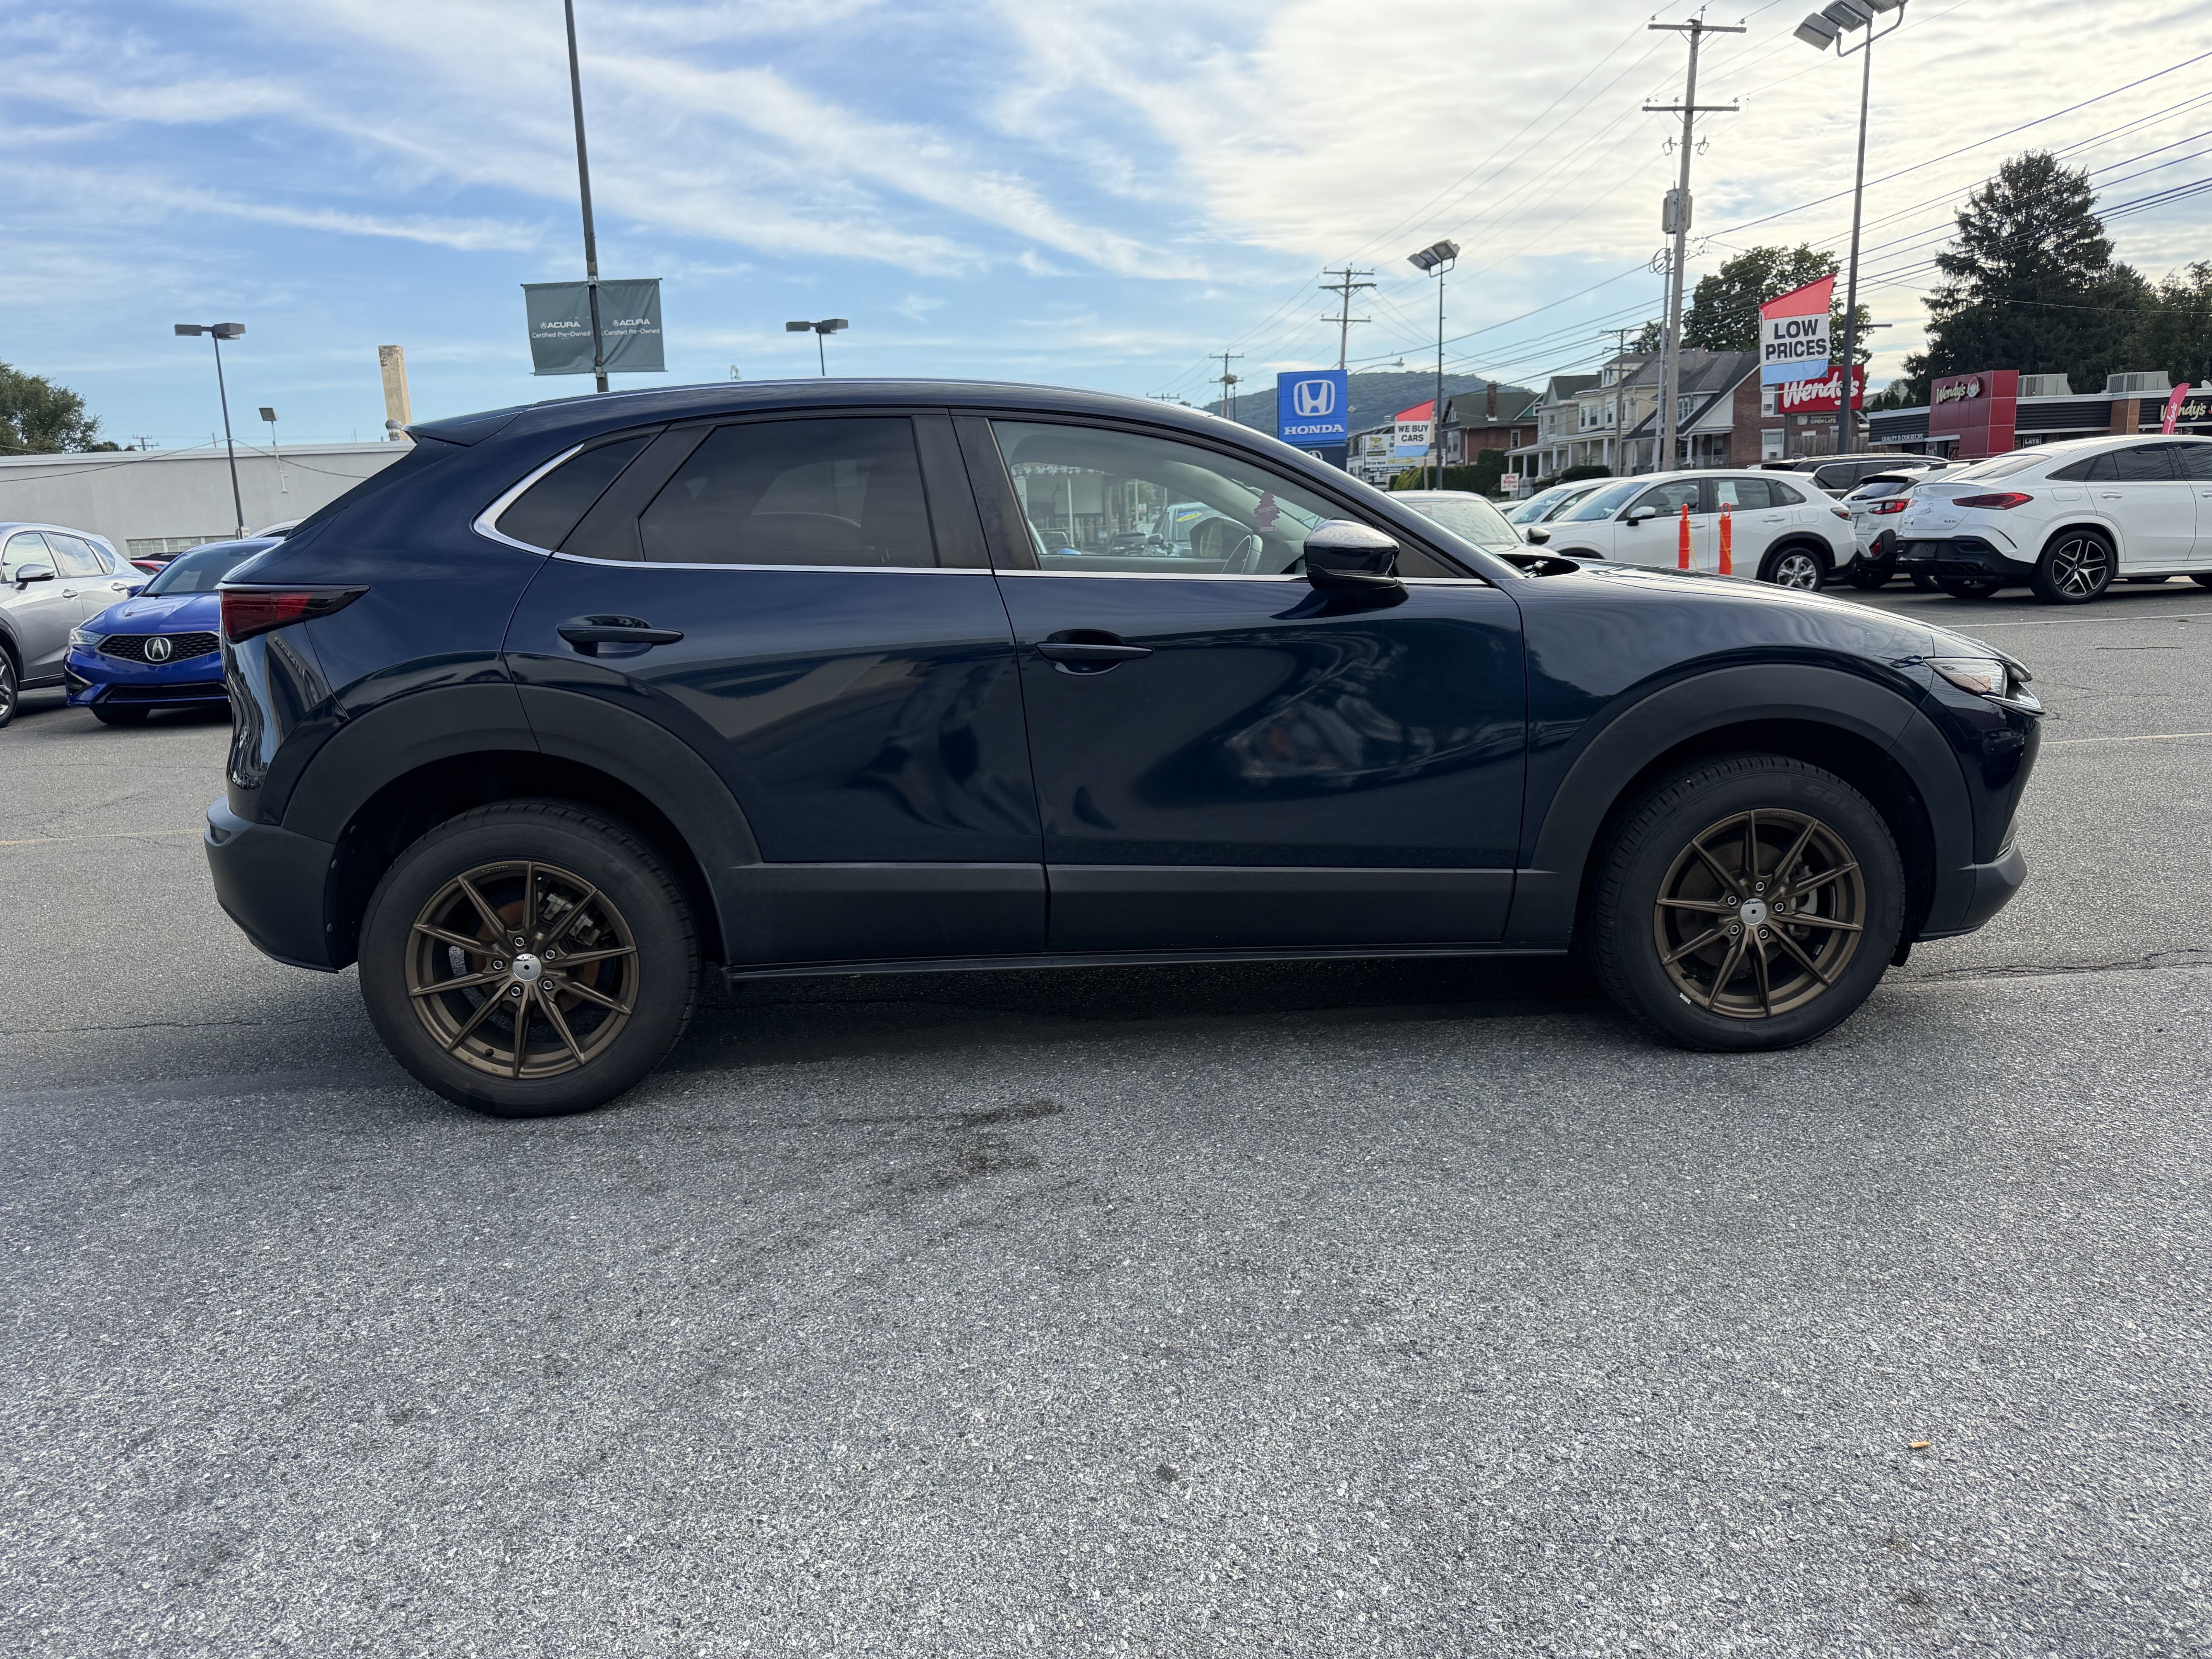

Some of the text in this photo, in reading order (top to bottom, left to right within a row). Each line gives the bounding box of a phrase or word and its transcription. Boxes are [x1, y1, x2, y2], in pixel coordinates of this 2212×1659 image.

[1774, 319, 1818, 340] LOW
[1765, 338, 1827, 360] PRICES
[1936, 381, 1966, 404] Wendy's
[1284, 424, 1345, 435] HONDA
